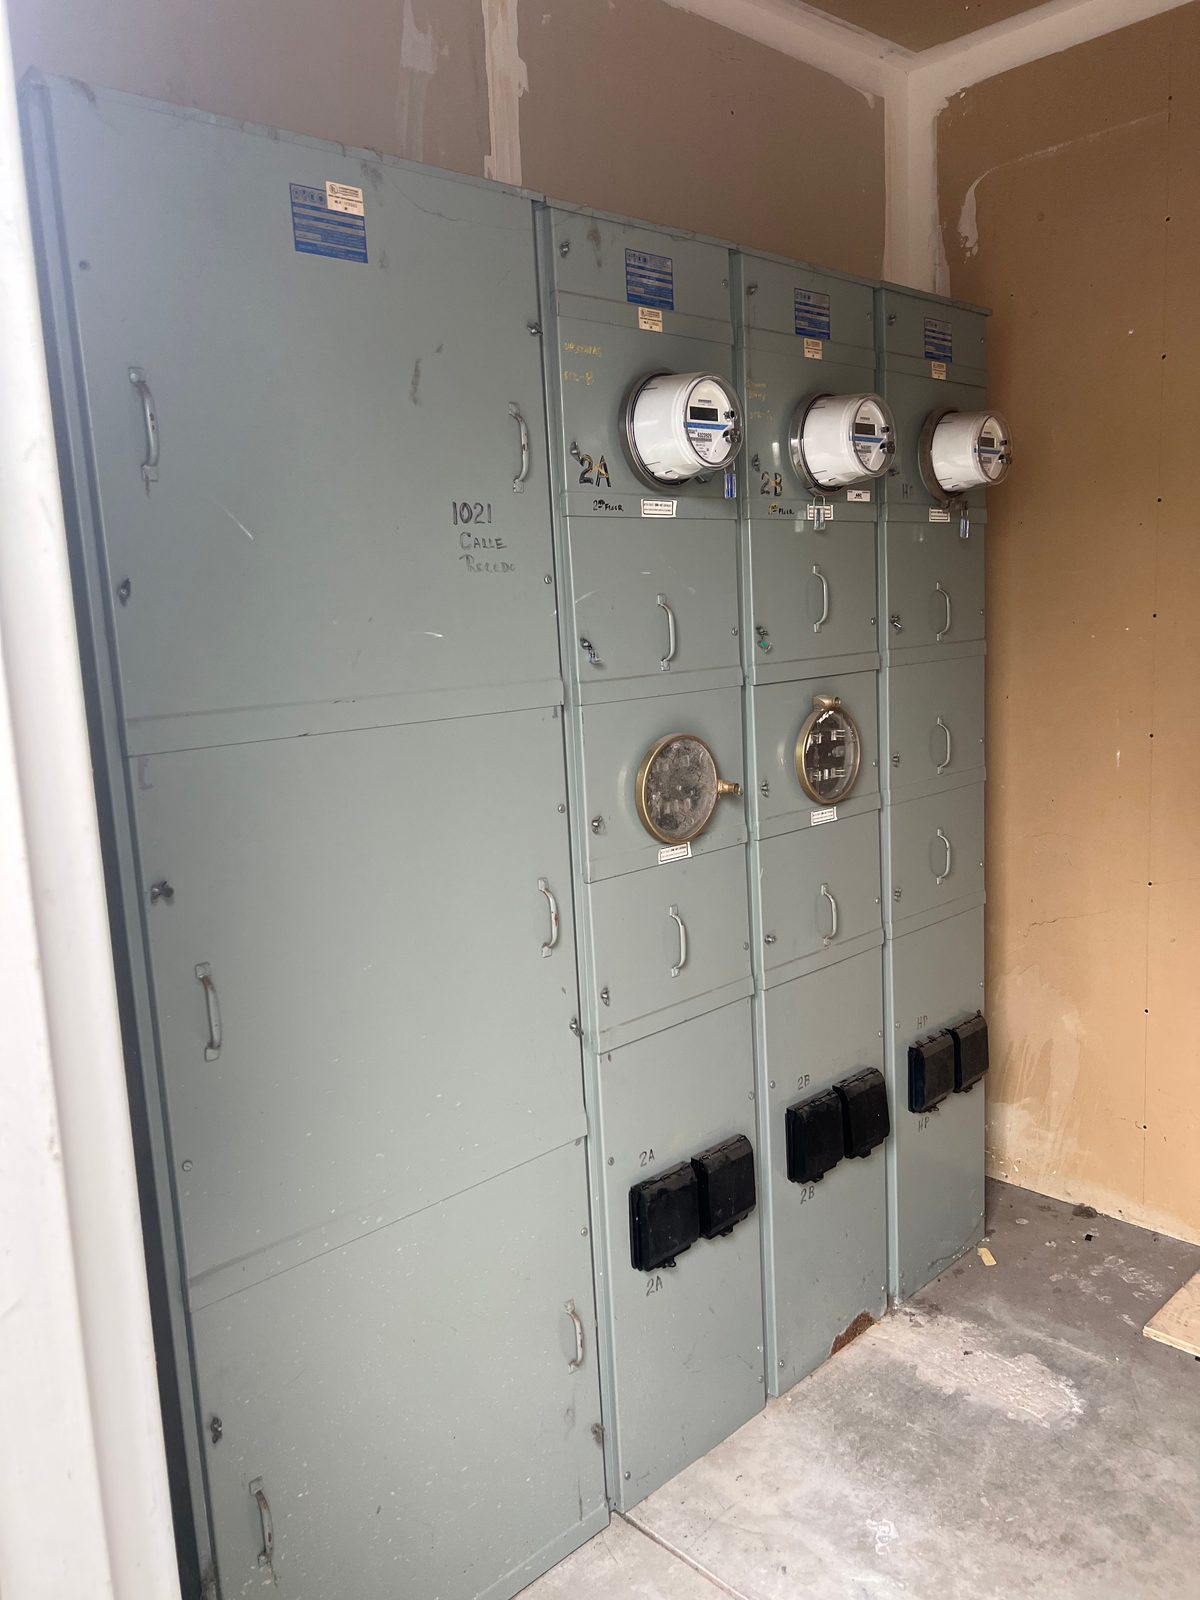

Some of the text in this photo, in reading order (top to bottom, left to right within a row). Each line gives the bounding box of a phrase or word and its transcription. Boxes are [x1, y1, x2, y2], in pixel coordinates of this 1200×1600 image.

[578, 454, 611, 487] 2A
[760, 471, 783, 497] 2B
[452, 501, 492, 525] 1021
[460, 532, 507, 549] CALLE
[797, 1074, 811, 1090] 2B
[639, 1149, 655, 1168] 2A
[800, 1185, 815, 1205] 2B
[646, 1275, 663, 1297] 2A
